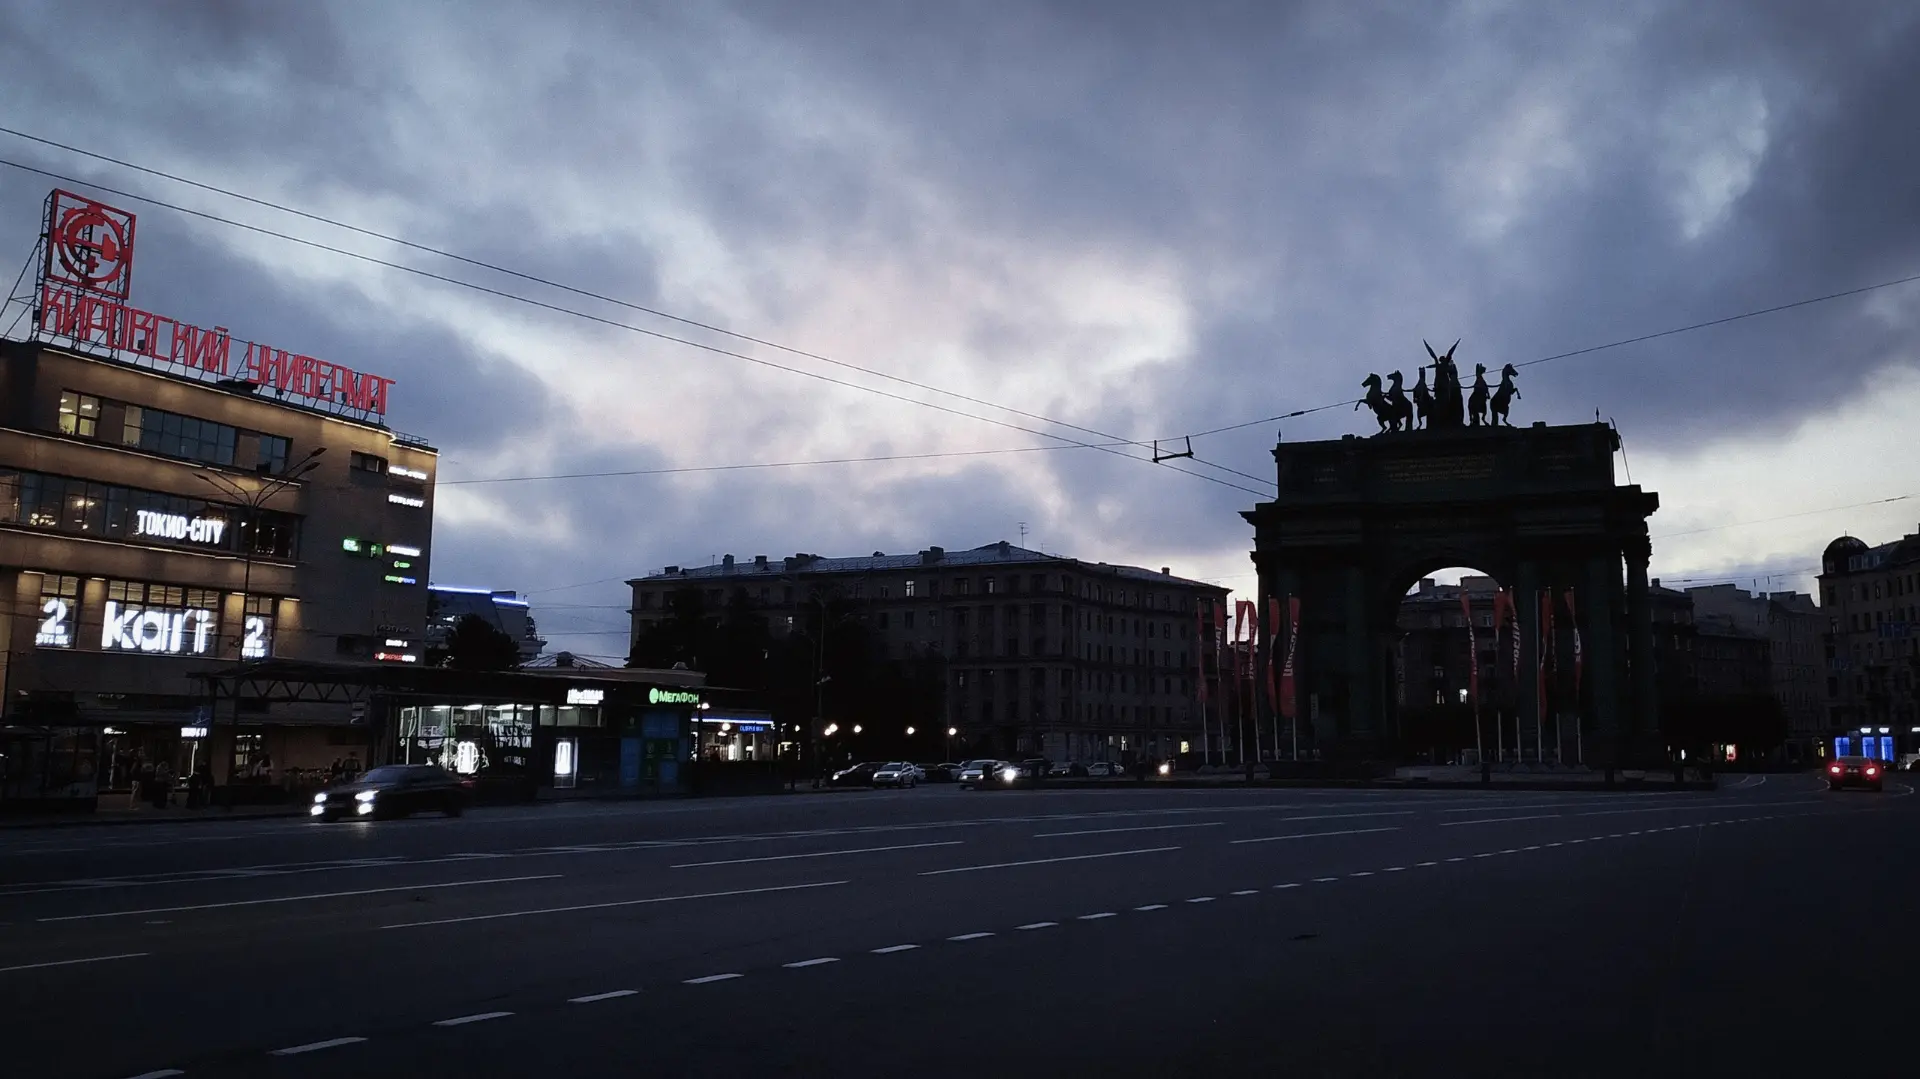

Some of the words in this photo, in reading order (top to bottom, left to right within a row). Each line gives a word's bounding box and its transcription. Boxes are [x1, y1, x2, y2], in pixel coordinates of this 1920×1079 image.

[40, 285, 230, 375] КИРОВСКИЙ
[247, 341, 396, 414] УНИВЕРМАГ
[137, 510, 224, 544] ТОКИО-CITY
[41, 599, 66, 634] 2
[102, 602, 210, 653] kari
[244, 617, 264, 649] 2
